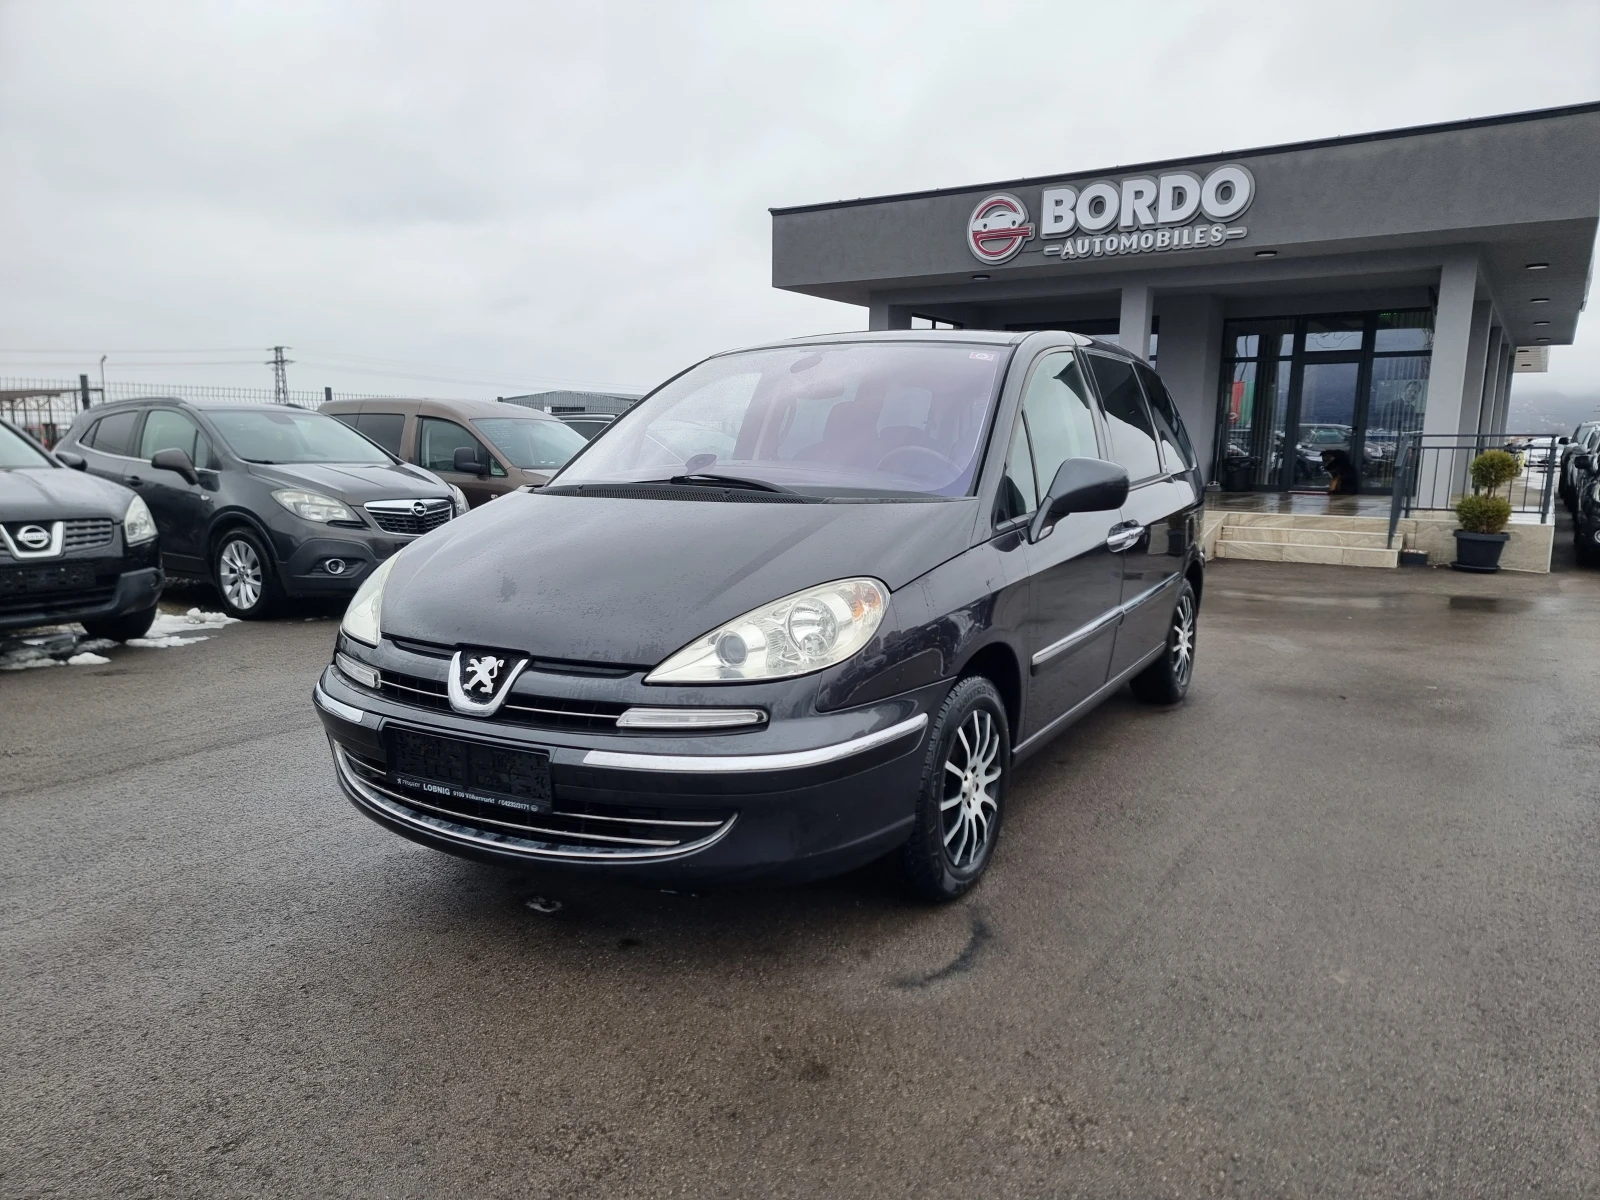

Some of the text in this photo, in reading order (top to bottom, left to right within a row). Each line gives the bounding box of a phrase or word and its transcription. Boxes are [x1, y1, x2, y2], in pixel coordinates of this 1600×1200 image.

[1041, 167, 1251, 235] BORDO
[1062, 226, 1223, 255] AUTOMOBILES
[423, 784, 450, 795] LOBNIG
